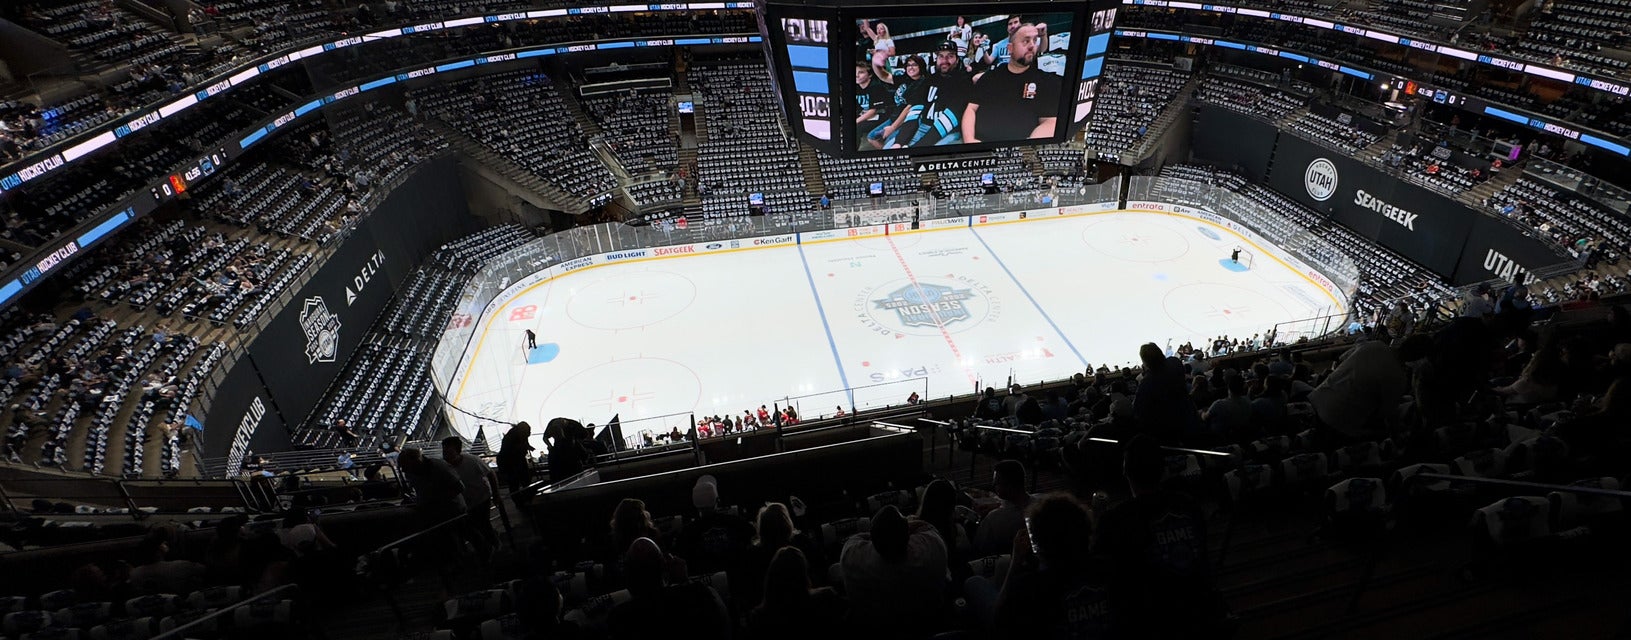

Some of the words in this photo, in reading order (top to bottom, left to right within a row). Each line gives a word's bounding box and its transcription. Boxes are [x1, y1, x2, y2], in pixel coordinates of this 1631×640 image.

[1478, 55, 1491, 64] UTAH
[1490, 58, 1510, 68] HOCKEY
[1509, 62, 1524, 72] CLUB
[1575, 76, 1591, 86] UTAH
[1590, 79, 1613, 92] HOCKEY
[1611, 85, 1630, 96] CLUB
[115, 124, 131, 138] UTAH
[128, 116, 148, 132] HOCKEY
[146, 111, 161, 124] CLUB
[1530, 119, 1545, 129] UTAH
[1544, 123, 1565, 135] HOCKEY
[1564, 129, 1579, 140] CLUB
[1, 173, 22, 191] UTAH
[18, 162, 47, 183] HOCKEY
[44, 154, 64, 170] CLUB
[162, 183, 171, 196] 0
[212, 154, 221, 166] 0
[928, 161, 959, 171] DELTA
[962, 158, 996, 168] CENTER
[1310, 169, 1333, 191] UTAH
[1131, 202, 1163, 210] entrata
[1354, 189, 1419, 232] SEATGEEK
[654, 244, 695, 256] SEATGEEK
[760, 238, 775, 246] Ken
[775, 236, 793, 244] Garff
[21, 266, 41, 285] UTAH
[36, 251, 62, 274] HOCKEY
[58, 241, 79, 259] CLUB
[560, 256, 592, 268] AMERICAN
[624, 250, 646, 259] LIGHT
[354, 249, 386, 292] DELTA
[565, 261, 594, 271] EXPRESS
[1308, 271, 1333, 292] entrata
[307, 310, 330, 342] SEASON
[1156, 526, 1195, 545] GAME
[1067, 600, 1109, 624] GAME
